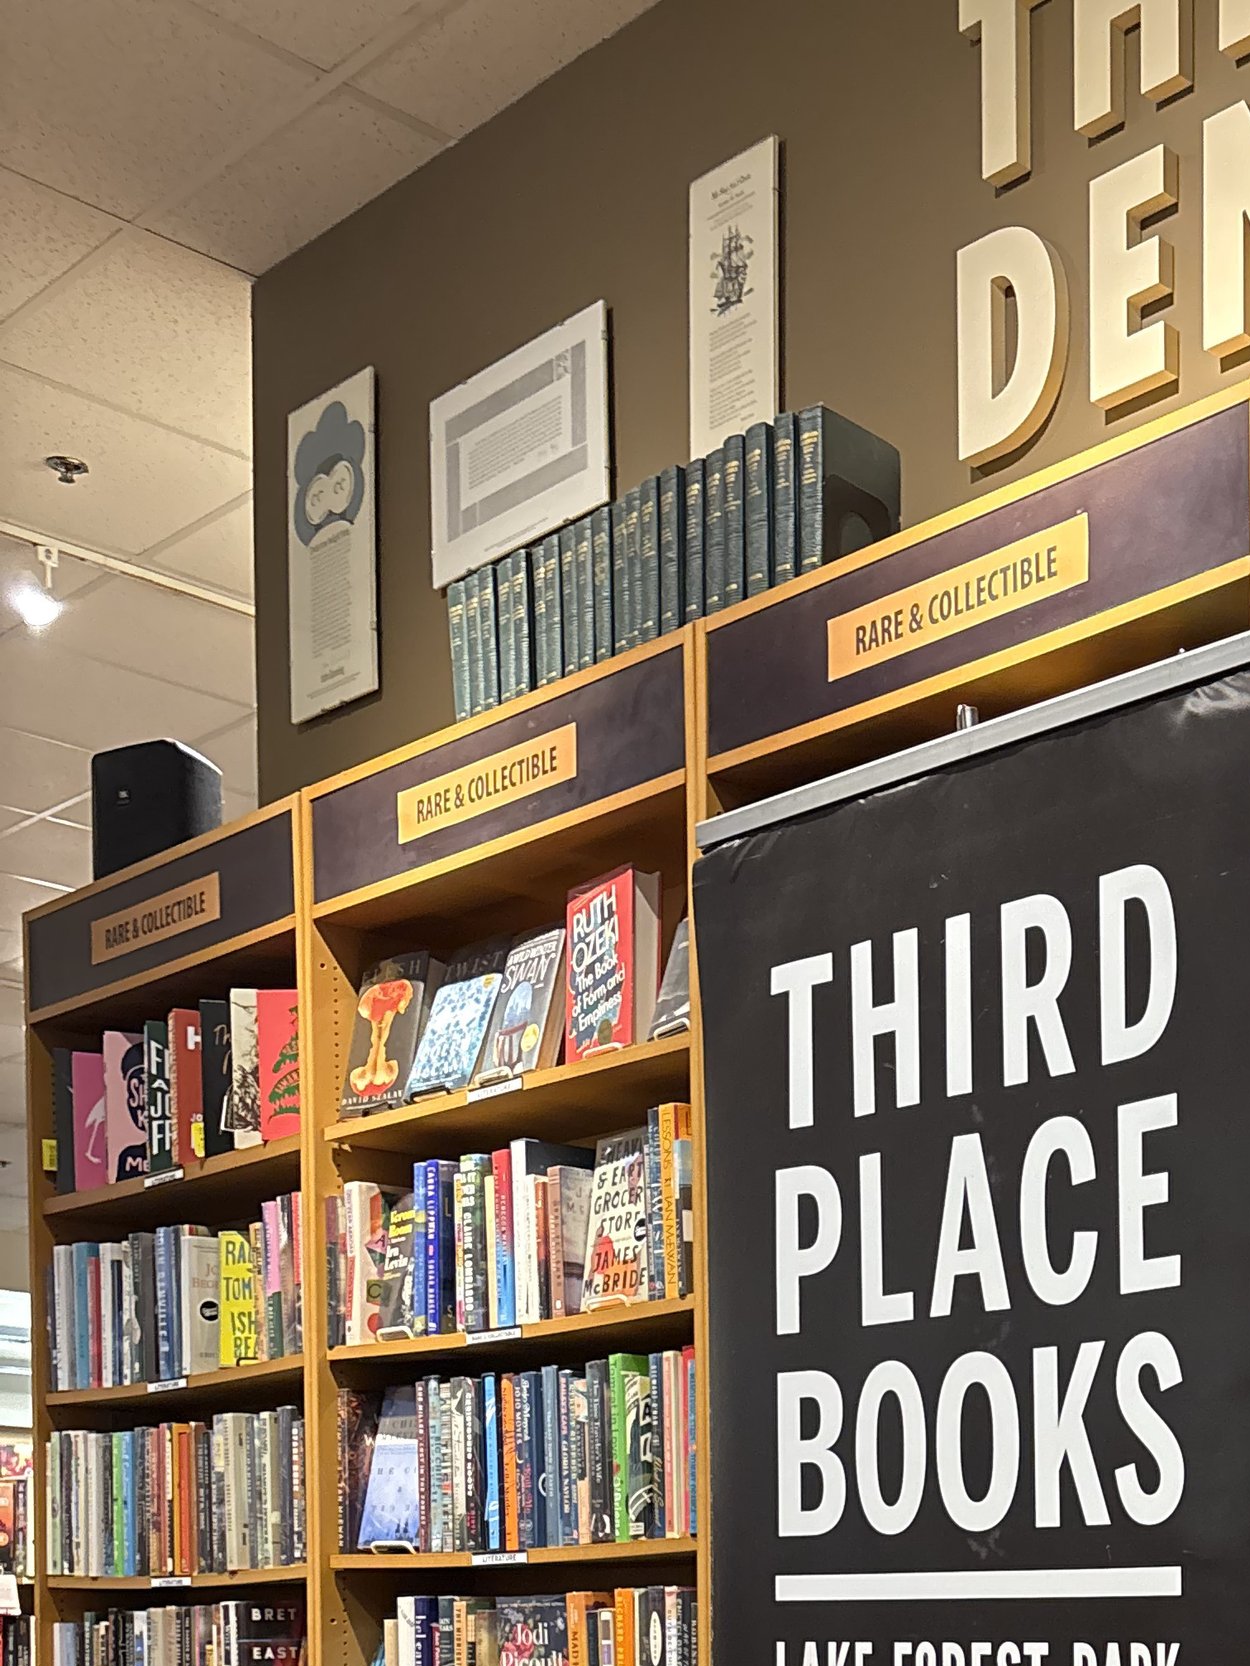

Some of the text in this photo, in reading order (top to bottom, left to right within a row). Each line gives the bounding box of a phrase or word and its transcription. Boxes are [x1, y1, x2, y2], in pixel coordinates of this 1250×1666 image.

[855, 546, 1059, 658] RARE & COLLECTIBLE
[416, 746, 558, 826] RARE & COLLECTIBLE
[105, 891, 205, 949] RARE & COLLECTIBLE
[572, 885, 616, 944] RUTH
[572, 914, 620, 974] OZEKI
[770, 863, 1178, 1130] THIRD
[775, 1092, 1181, 1336] PLACE
[583, 1266, 647, 1298] McBRIDE
[592, 1245, 638, 1274] JAMES
[776, 1331, 1185, 1538] BOOKS
[250, 1608, 297, 1622] BRET
[514, 1622, 549, 1647] Jodi
